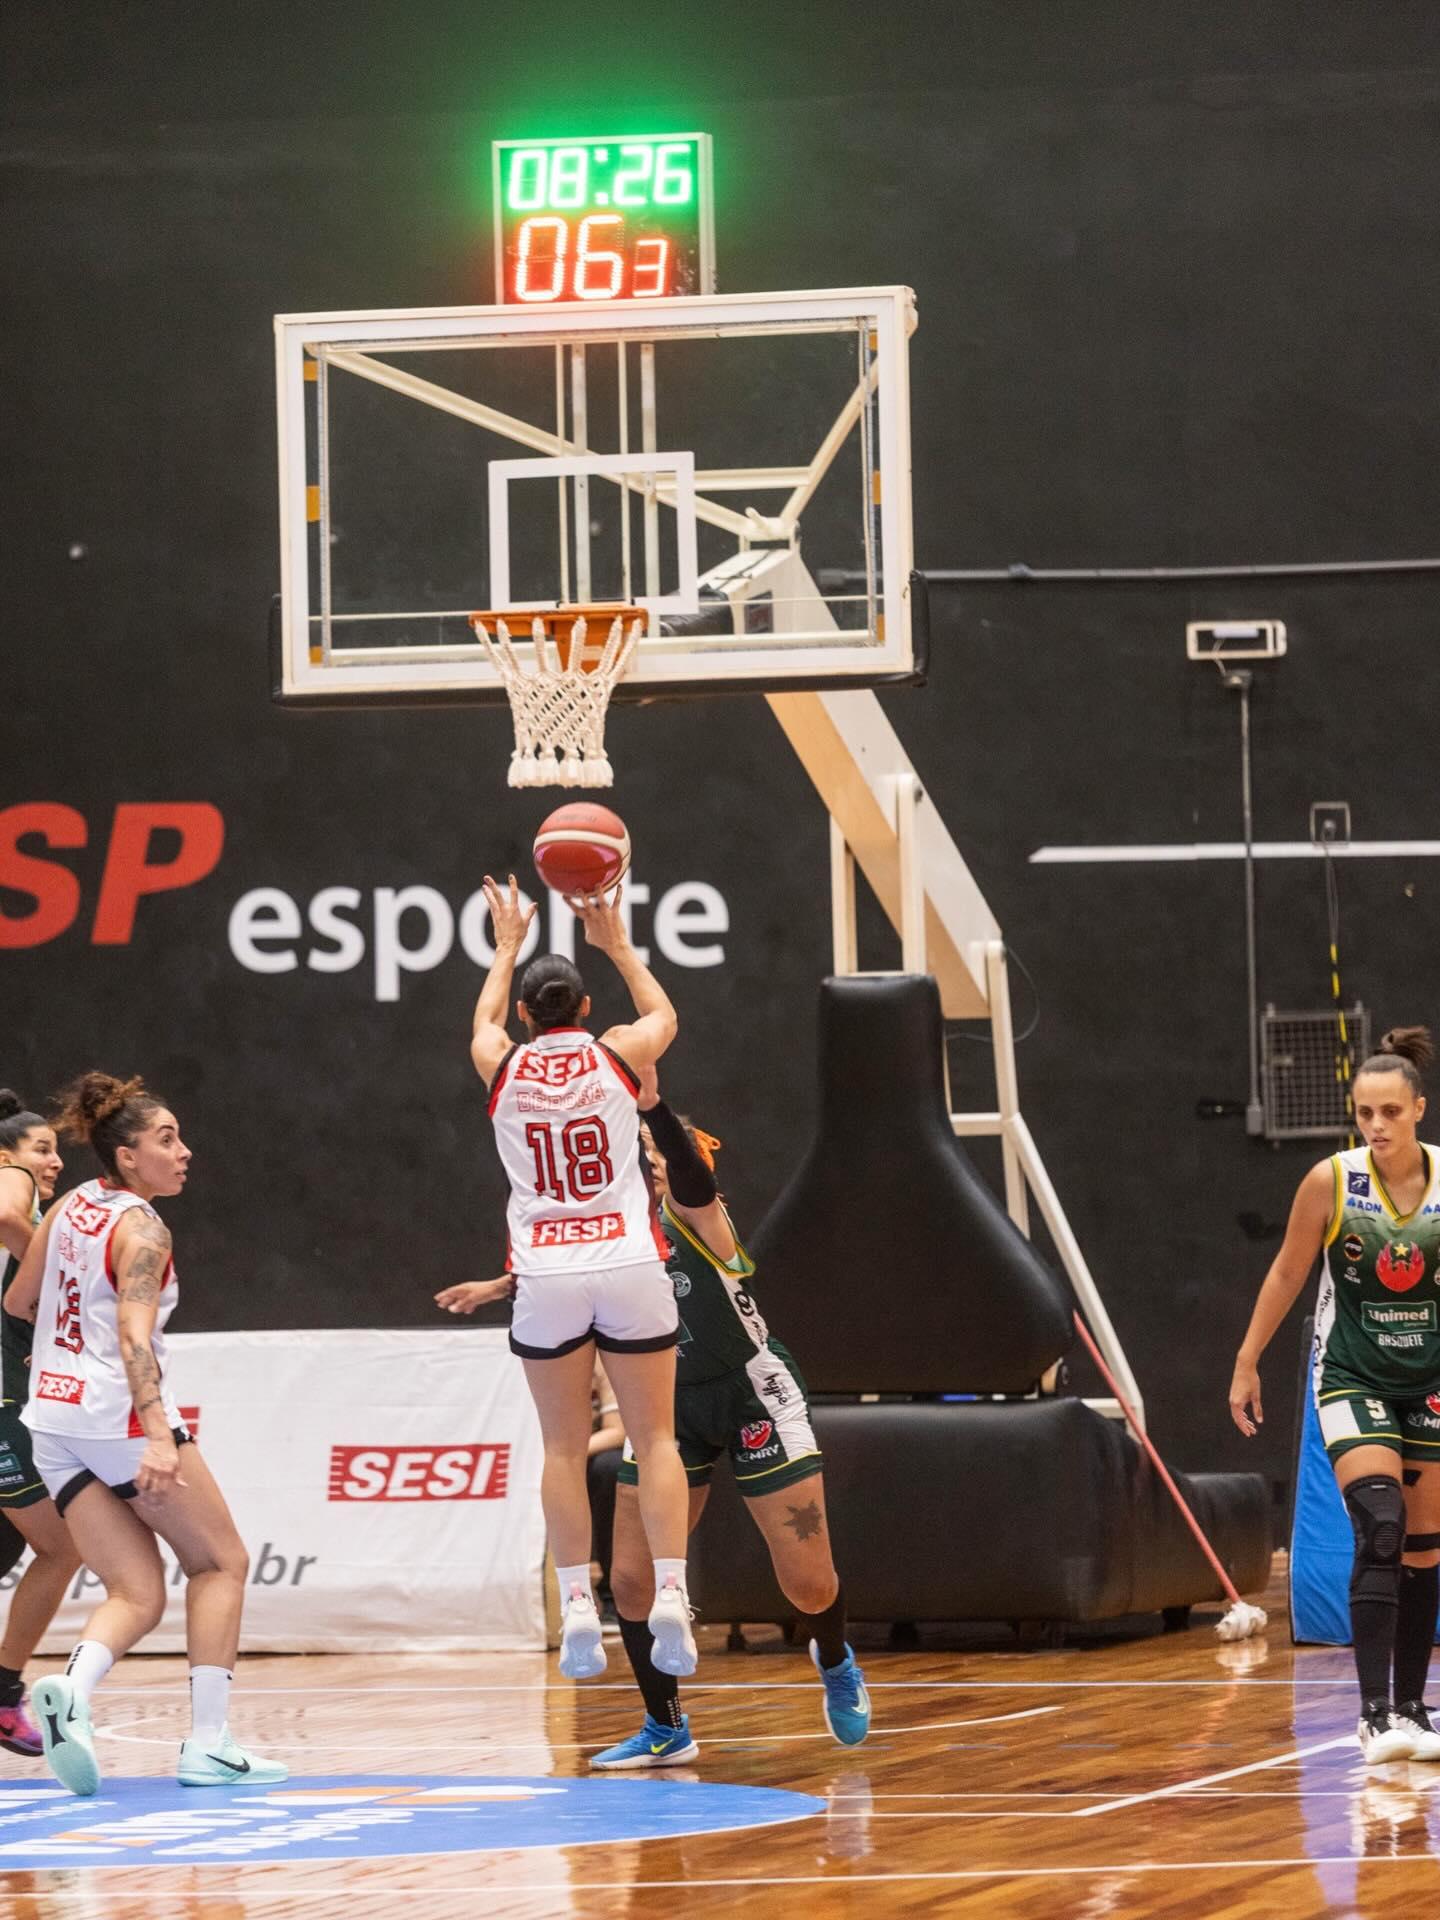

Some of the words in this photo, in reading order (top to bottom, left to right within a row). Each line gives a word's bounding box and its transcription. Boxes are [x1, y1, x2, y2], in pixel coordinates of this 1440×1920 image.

[508, 144, 692, 210] 08:26
[525, 1115, 613, 1203] 18
[1357, 1200, 1382, 1214] ADN
[539, 1216, 620, 1245] FIESP
[1368, 1308, 1429, 1323] Unimed
[1378, 1333, 1424, 1347] BASQUETE
[749, 1443, 779, 1460] MRV
[343, 1449, 496, 1498] SESI
